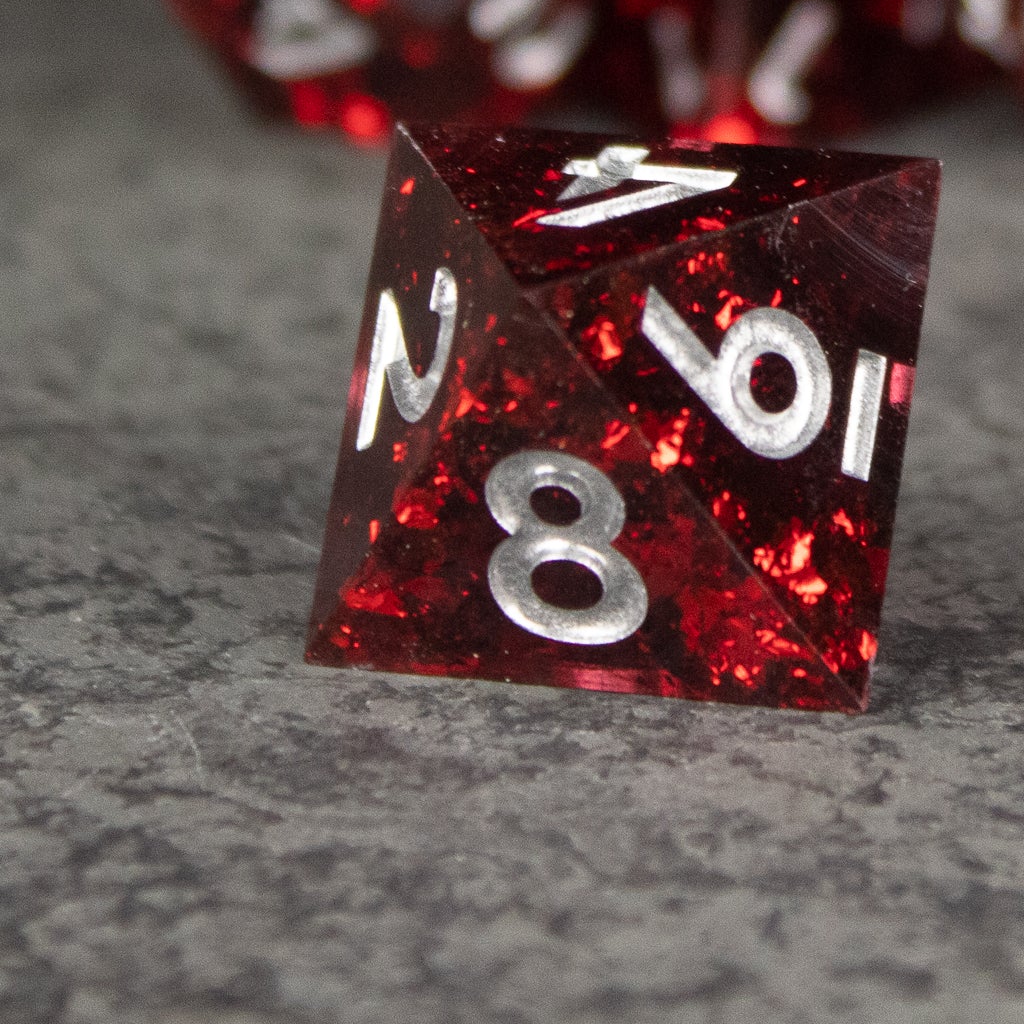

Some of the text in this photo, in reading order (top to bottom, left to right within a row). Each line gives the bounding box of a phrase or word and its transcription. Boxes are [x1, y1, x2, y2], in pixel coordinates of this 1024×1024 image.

[536, 146, 738, 228] 4
[356, 267, 457, 452] 2
[484, 449, 649, 646] 8
